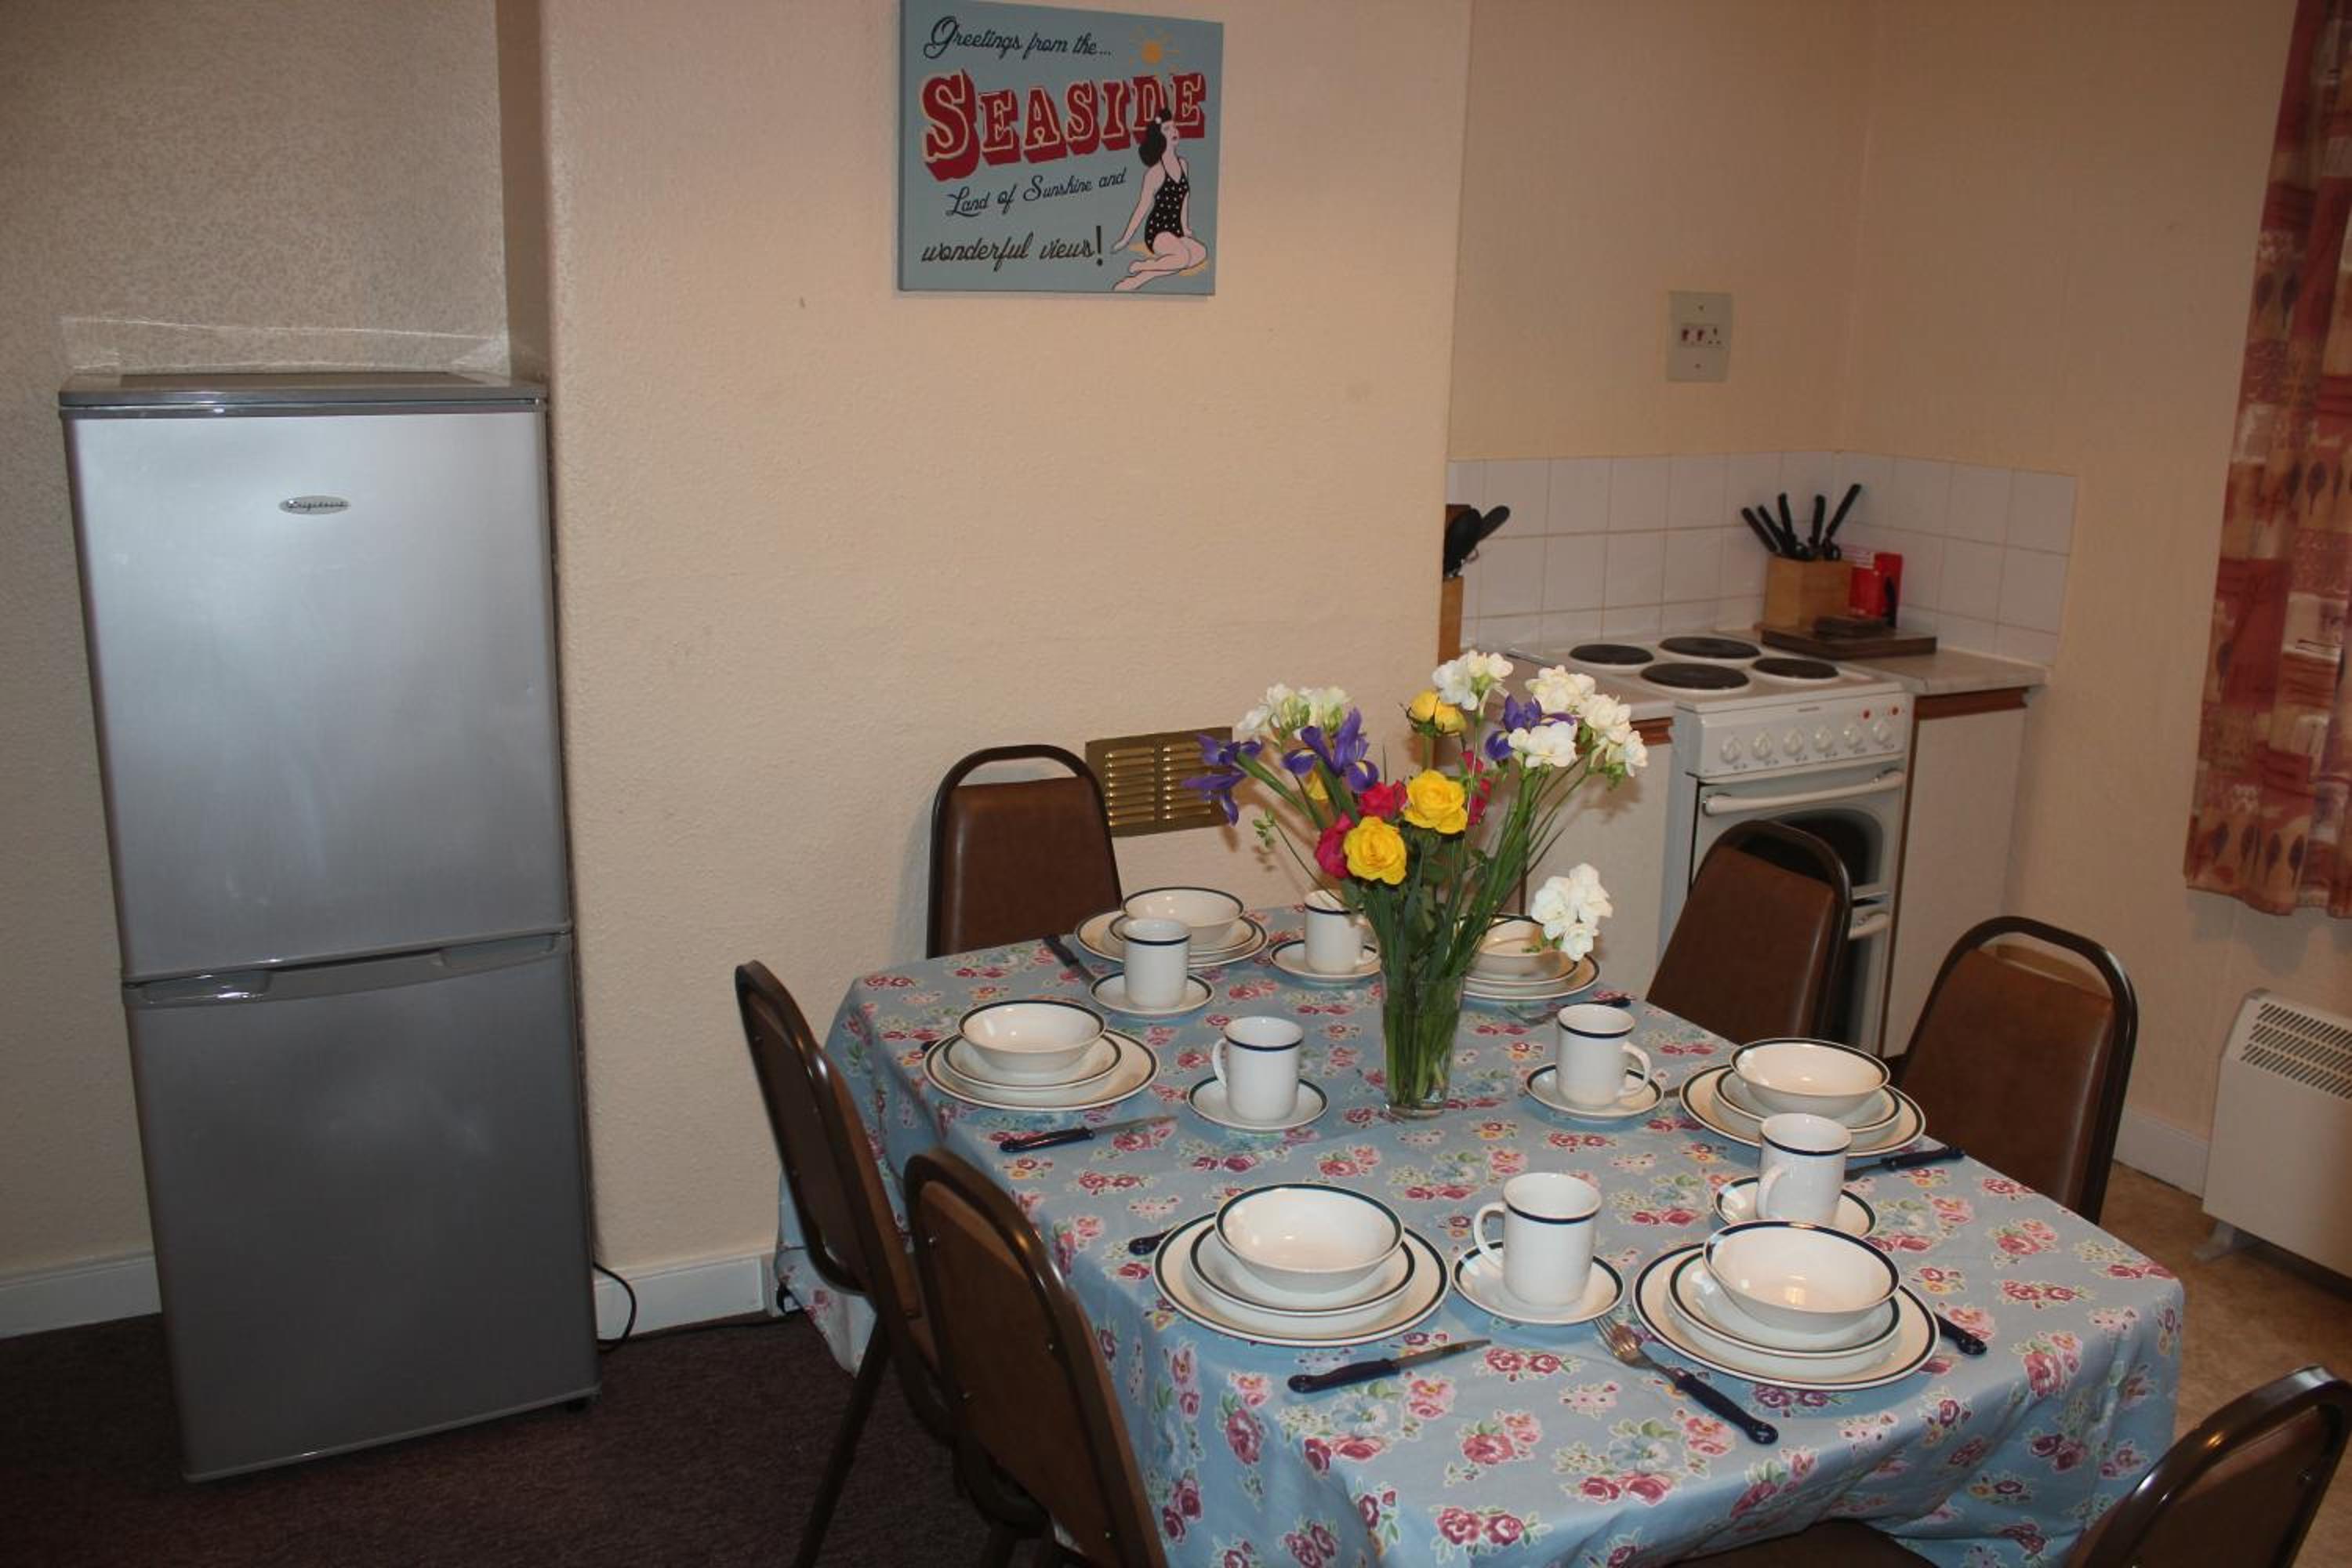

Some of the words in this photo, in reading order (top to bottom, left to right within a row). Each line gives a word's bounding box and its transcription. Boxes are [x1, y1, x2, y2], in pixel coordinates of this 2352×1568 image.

[924, 16, 1021, 60] Greetings
[1022, 32, 1068, 60] from
[921, 68, 1207, 182] SEASIDE
[946, 186, 991, 217] Land
[997, 185, 1016, 215] of
[1022, 175, 1094, 201] Sunshine
[1099, 167, 1127, 189] and
[922, 232, 1034, 271] wonderful
[1040, 225, 1104, 266] views!
